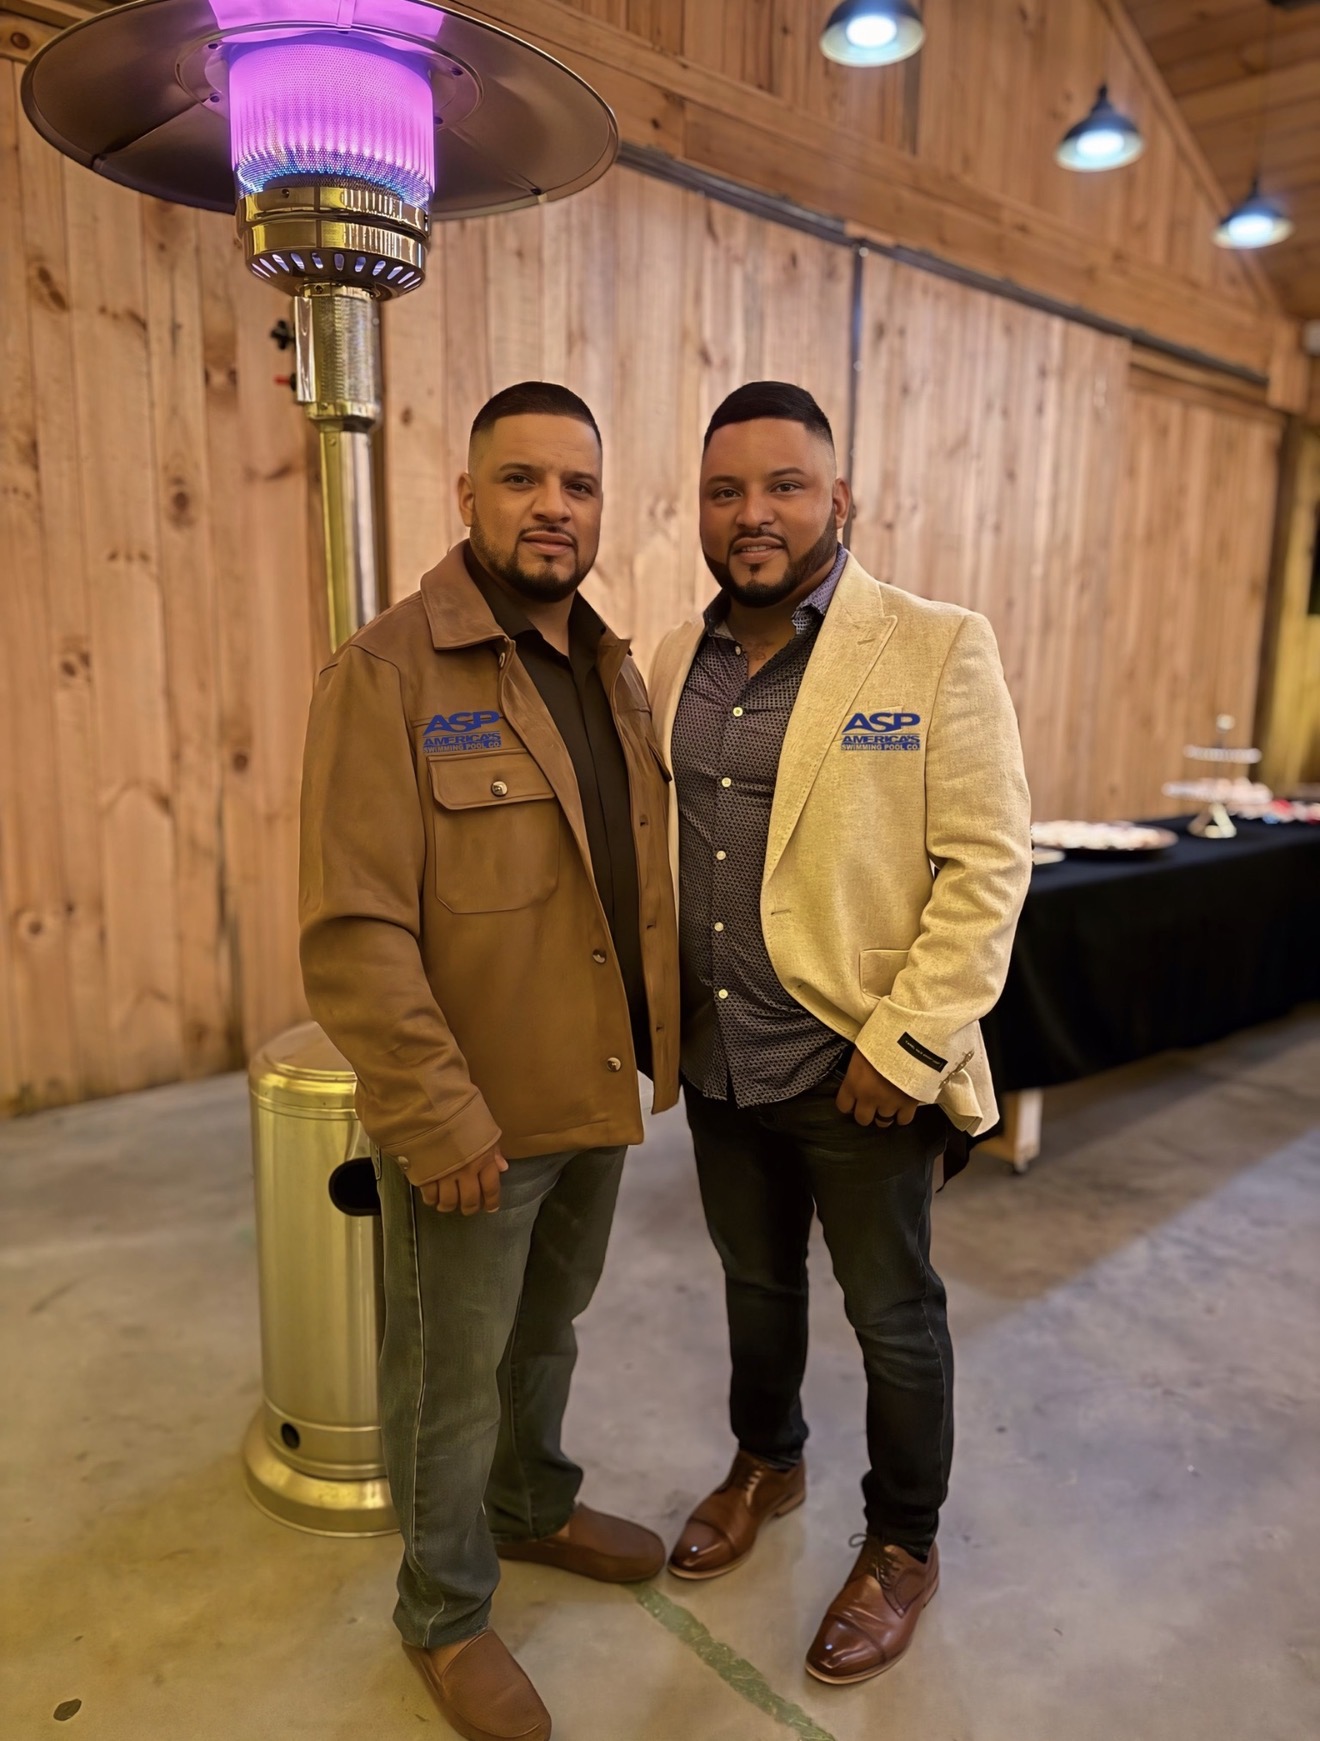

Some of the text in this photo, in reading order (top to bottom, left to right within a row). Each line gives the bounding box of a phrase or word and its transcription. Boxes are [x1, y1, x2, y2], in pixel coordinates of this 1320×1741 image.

[423, 711, 500, 735] ASP
[842, 713, 920, 732] ASP
[424, 733, 500, 745] AMERICA'S
[424, 745, 463, 753] SWIMMING
